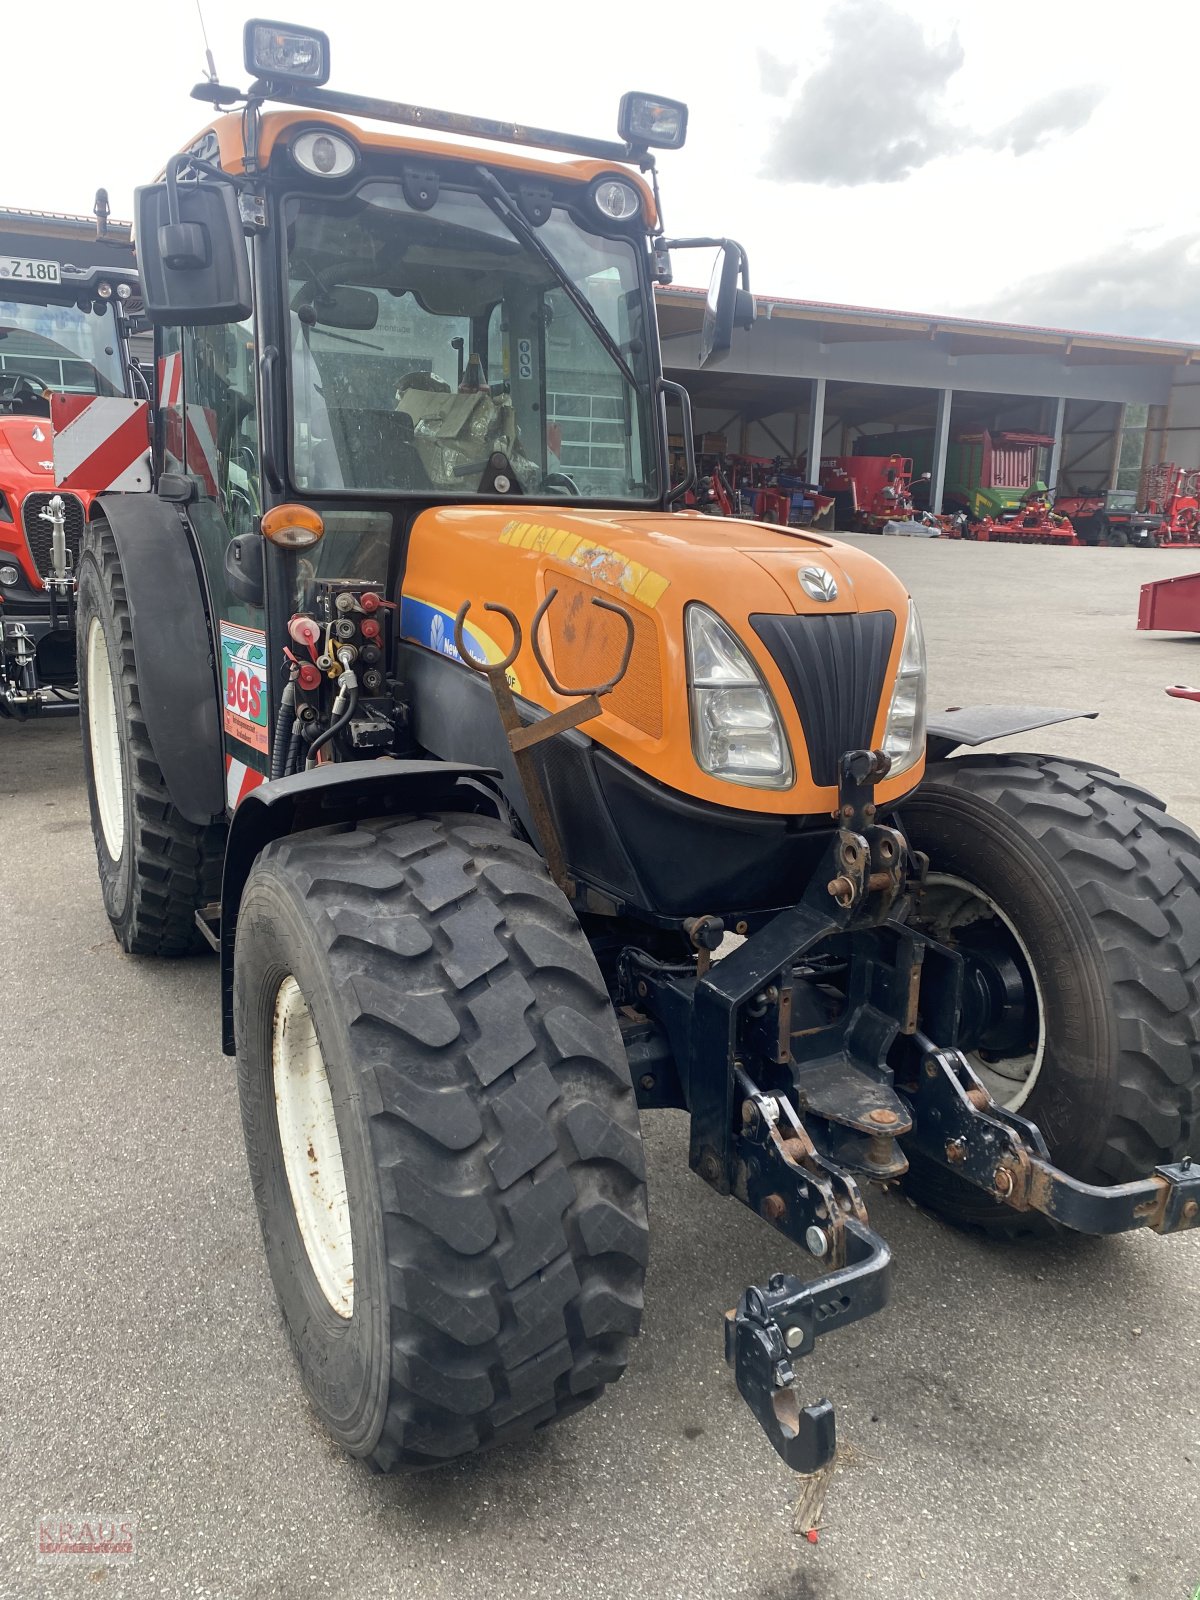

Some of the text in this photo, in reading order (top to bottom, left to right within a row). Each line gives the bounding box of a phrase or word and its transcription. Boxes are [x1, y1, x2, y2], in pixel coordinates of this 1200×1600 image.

[11, 261, 58, 280] Z 180
[444, 638, 458, 657] New
[227, 667, 261, 718] BGS
